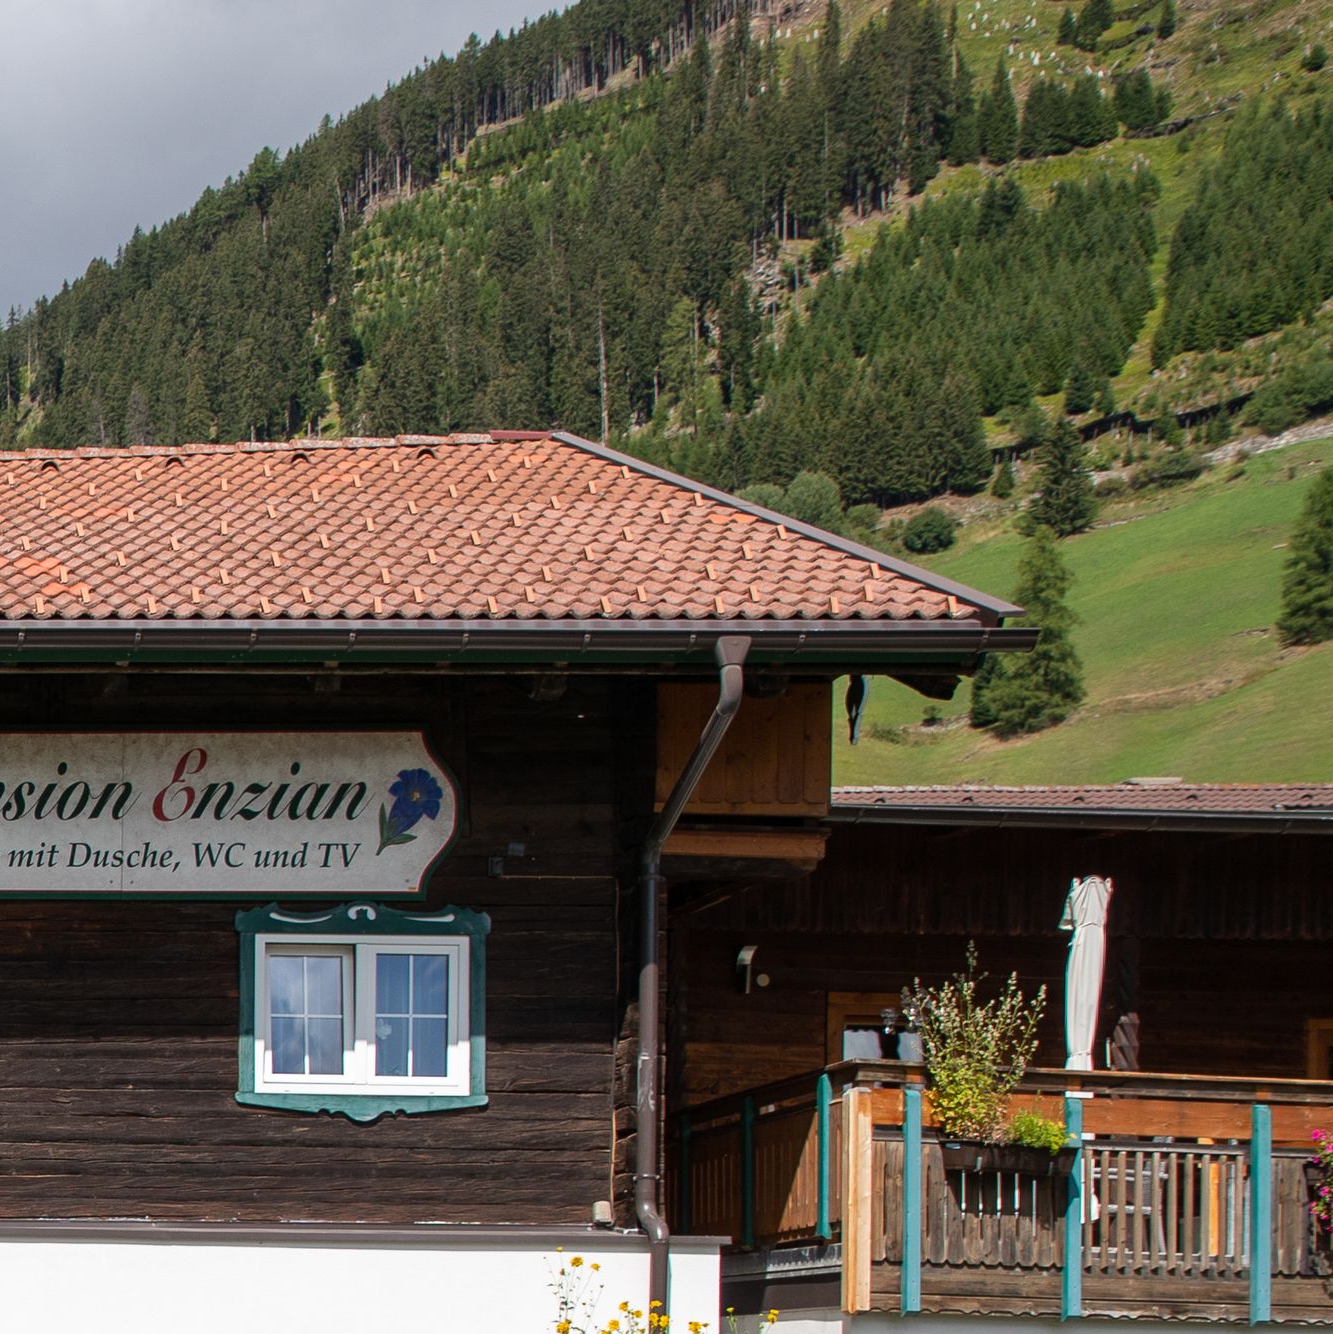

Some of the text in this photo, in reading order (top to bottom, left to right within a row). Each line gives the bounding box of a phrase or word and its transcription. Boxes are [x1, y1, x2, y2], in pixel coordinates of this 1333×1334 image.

[152, 747, 376, 822] Enzian
[8, 842, 60, 868] mit
[66, 841, 181, 873] Dusche,
[192, 842, 246, 868] WC
[253, 842, 309, 868] und
[318, 842, 362, 868] TV
